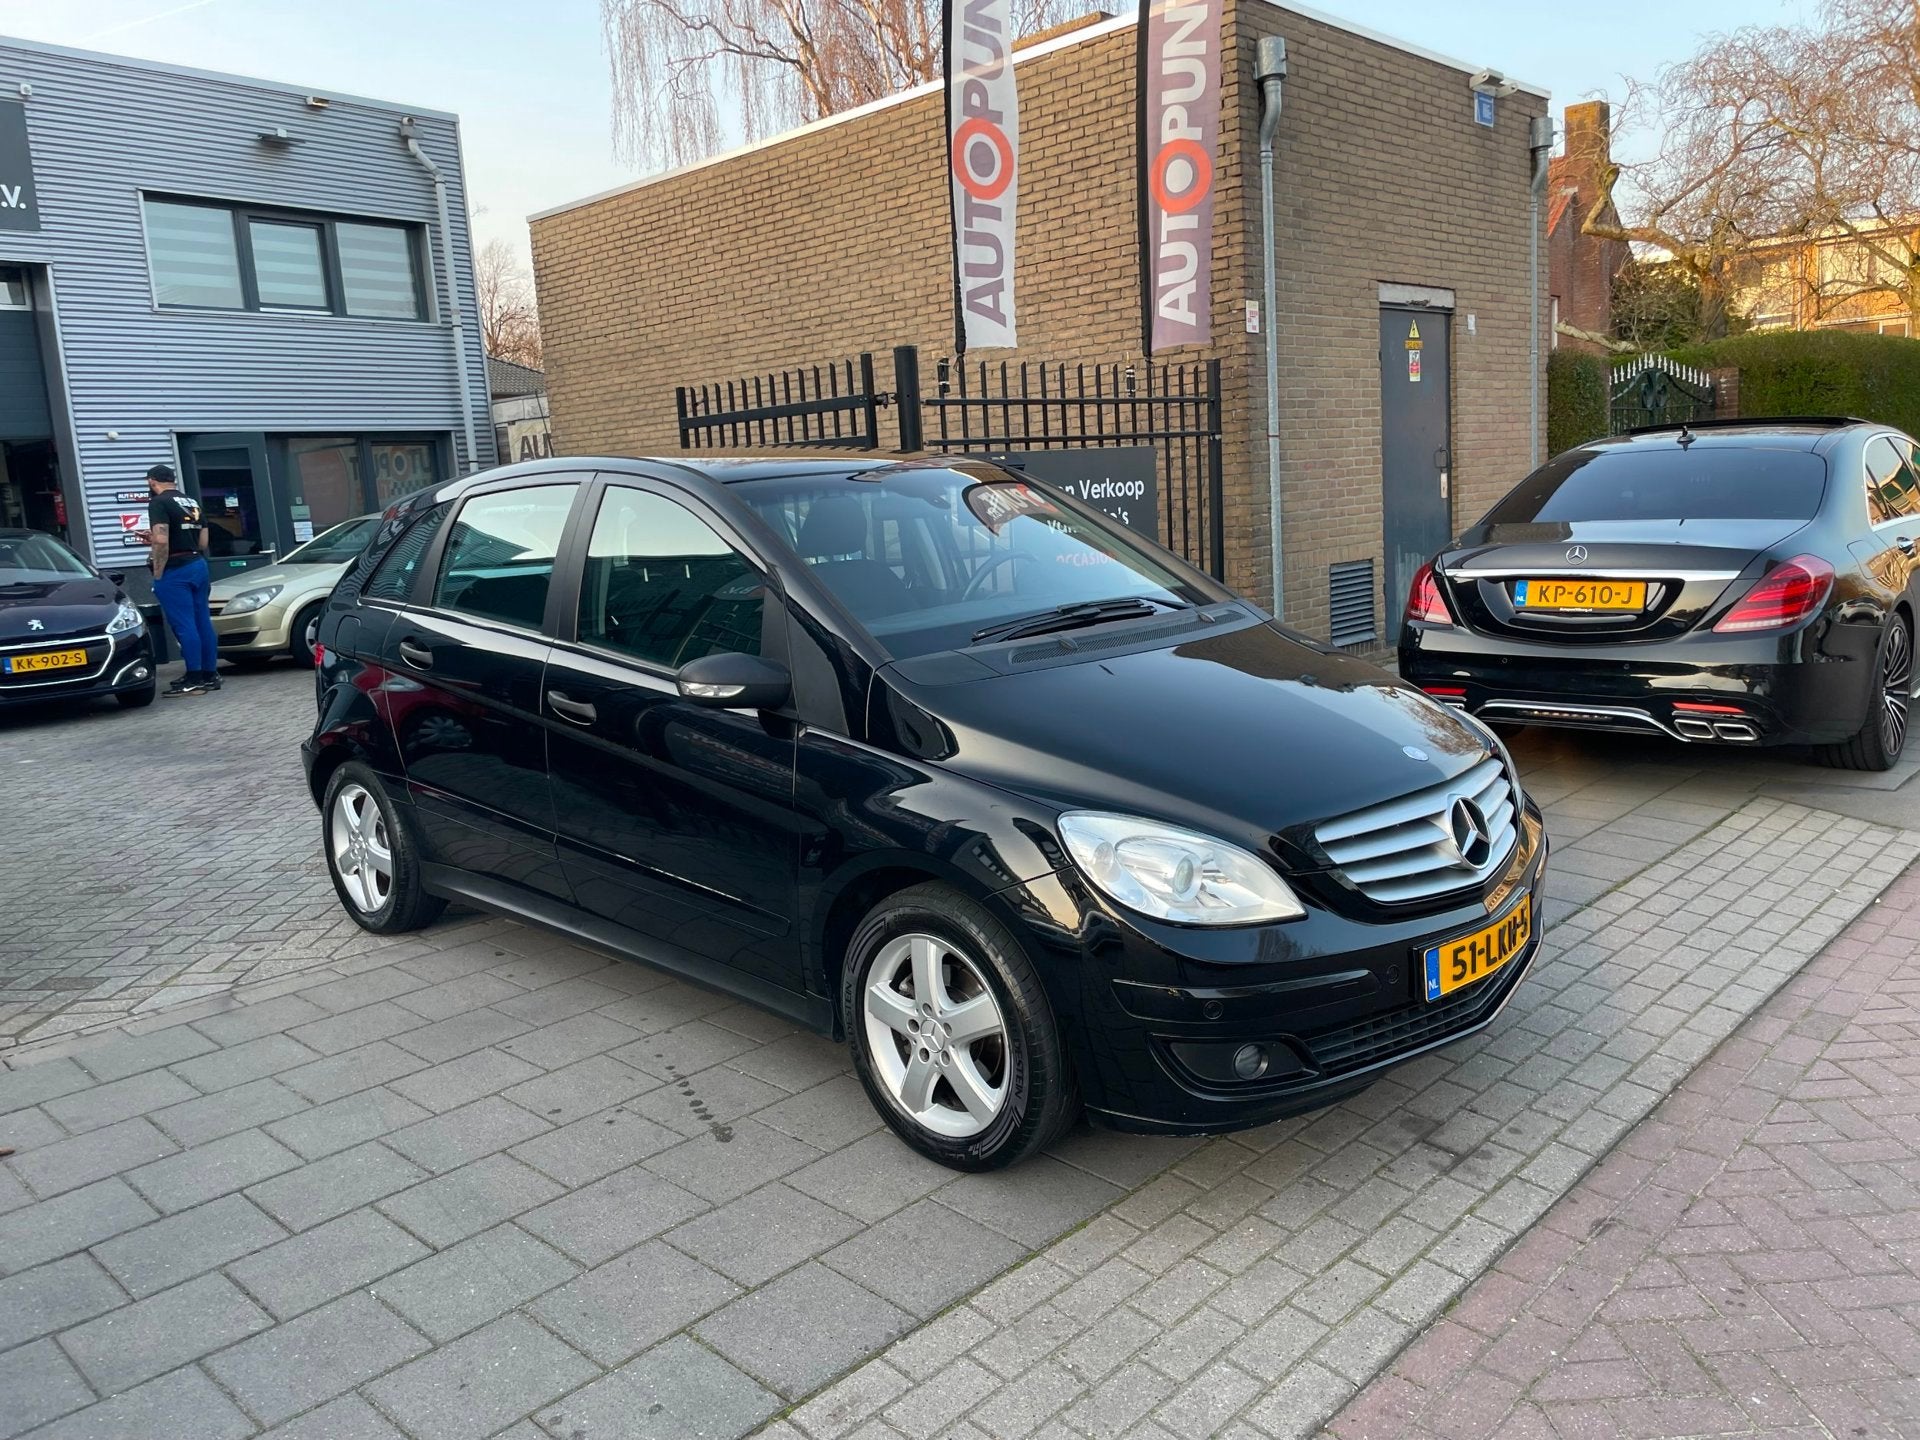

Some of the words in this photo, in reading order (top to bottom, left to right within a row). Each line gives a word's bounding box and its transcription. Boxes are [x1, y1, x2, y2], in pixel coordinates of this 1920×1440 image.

[1150, 0, 1213, 326] AUTOPUN
[1079, 478, 1144, 500] Verkoop
[1538, 585, 1633, 604] KP-610-J
[16, 652, 83, 670] KK-902-S
[1428, 978, 1438, 990] NL
[1452, 904, 1528, 982] 51-LKH-5
